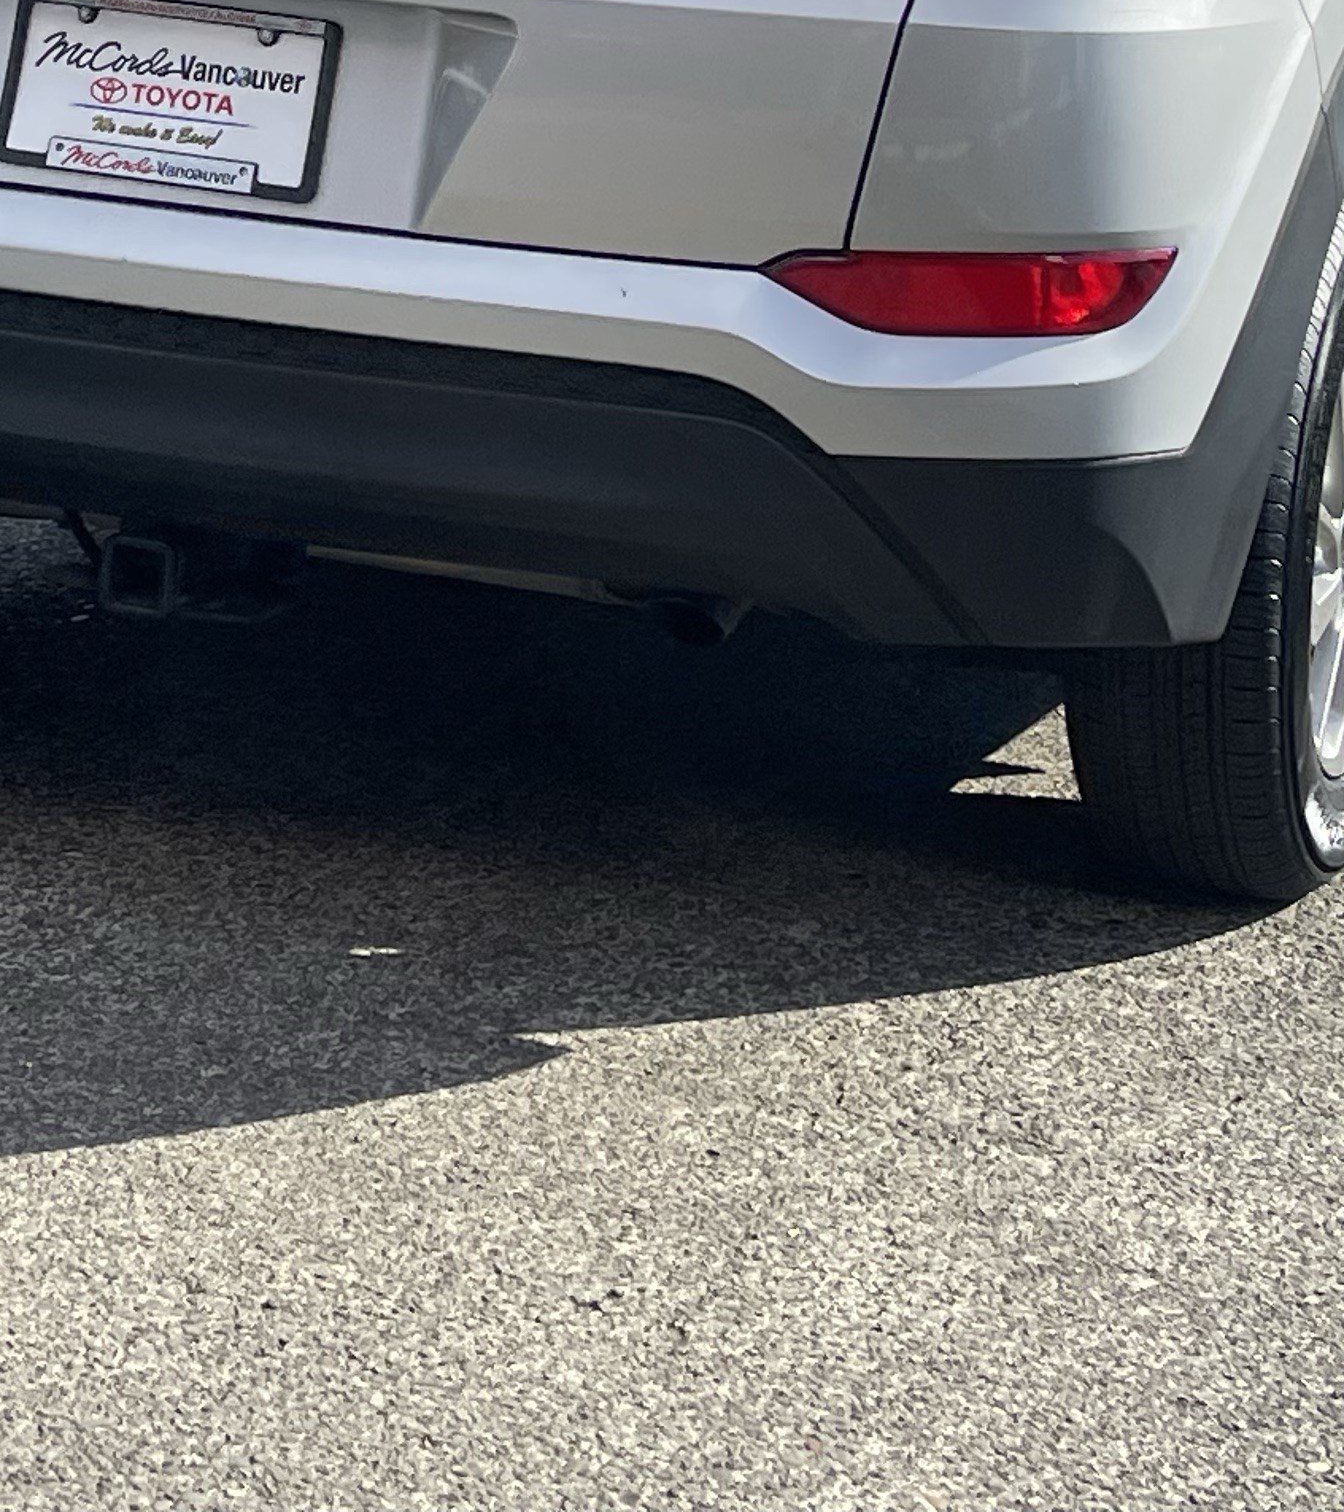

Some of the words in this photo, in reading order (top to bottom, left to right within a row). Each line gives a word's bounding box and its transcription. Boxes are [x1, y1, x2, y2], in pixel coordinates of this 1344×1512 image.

[180, 53, 306, 94] Vancouver
[132, 84, 234, 116] TOYOTA
[156, 160, 239, 185] Vancouver
